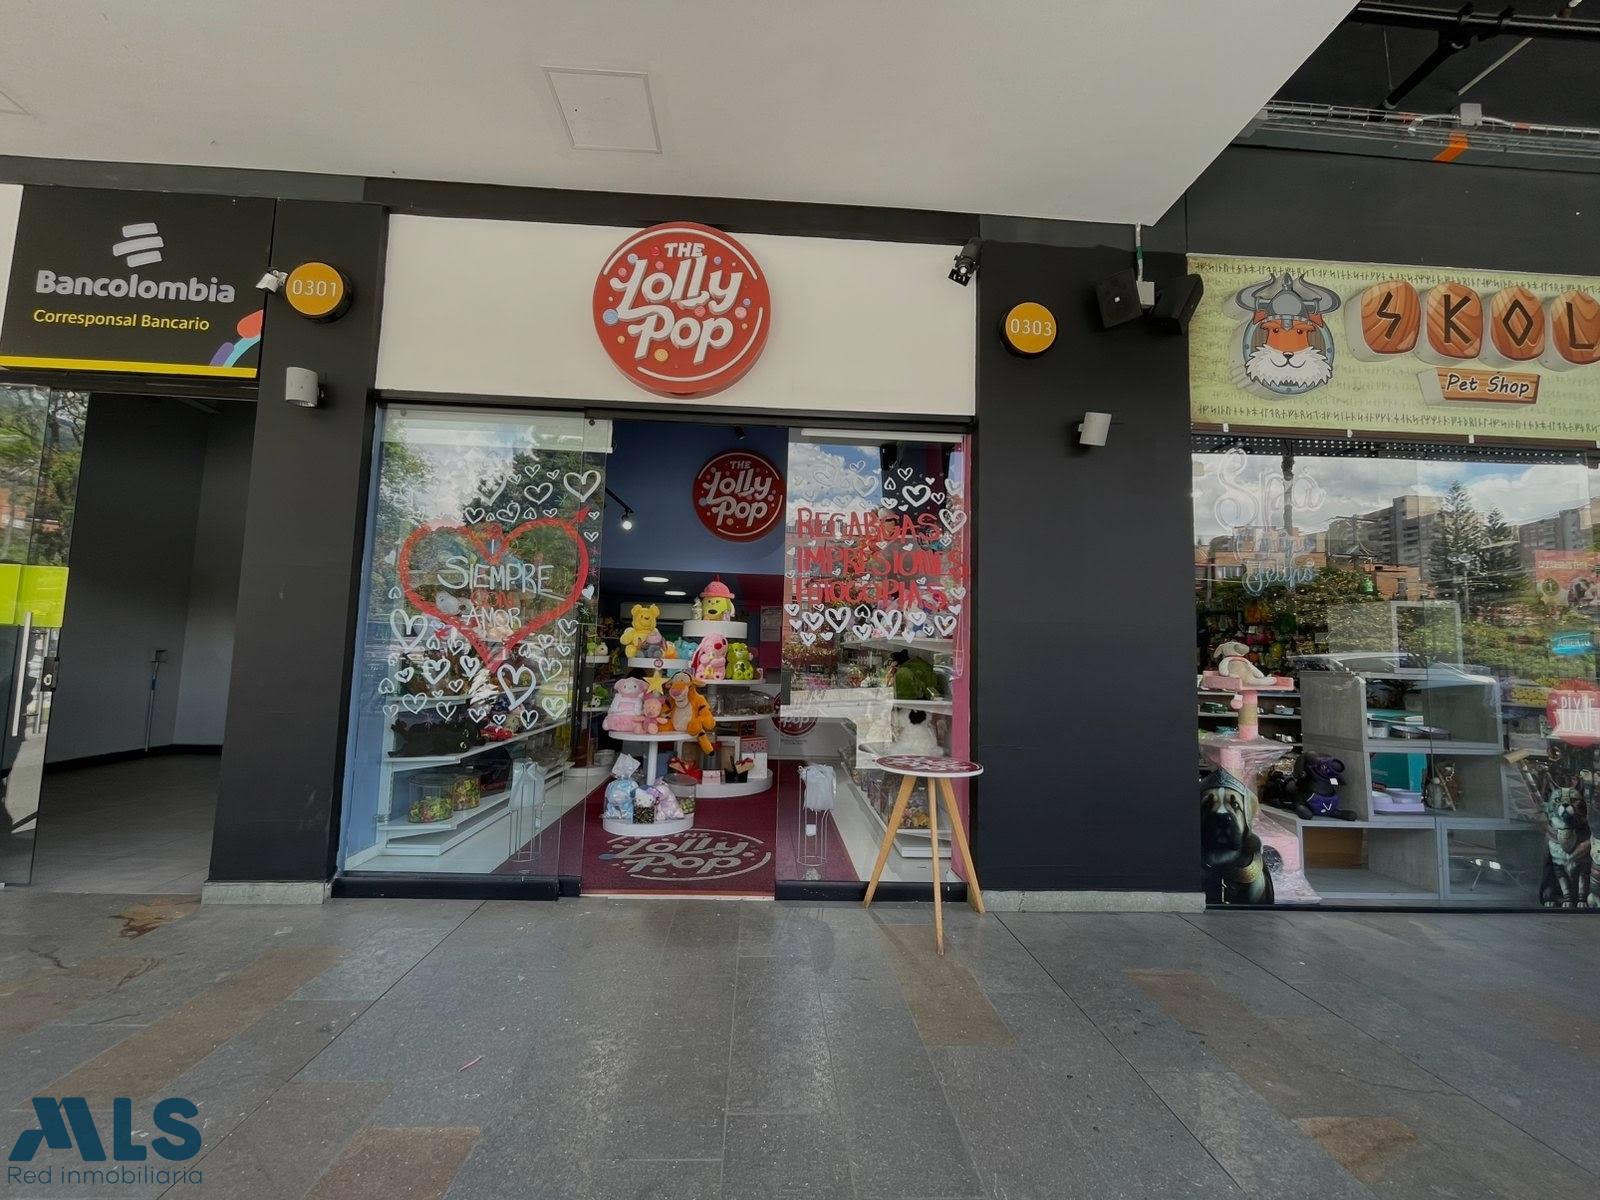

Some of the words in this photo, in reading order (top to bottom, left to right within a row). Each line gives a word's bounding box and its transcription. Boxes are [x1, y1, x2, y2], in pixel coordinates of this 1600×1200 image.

[664, 242, 705, 258] THE
[35, 269, 236, 303] Bancolombia
[292, 279, 337, 297] 0301
[33, 309, 137, 328] Corresponsal
[141, 314, 210, 331] Bancario
[1010, 318, 1052, 336] 0303
[1376, 291, 1594, 350] SKOL
[627, 304, 734, 365] Pop
[1446, 373, 1478, 391] Pet
[1487, 375, 1530, 398] Shop
[729, 460, 752, 469] THE
[711, 496, 768, 527] Pop
[436, 555, 555, 594] SIEMPRE
